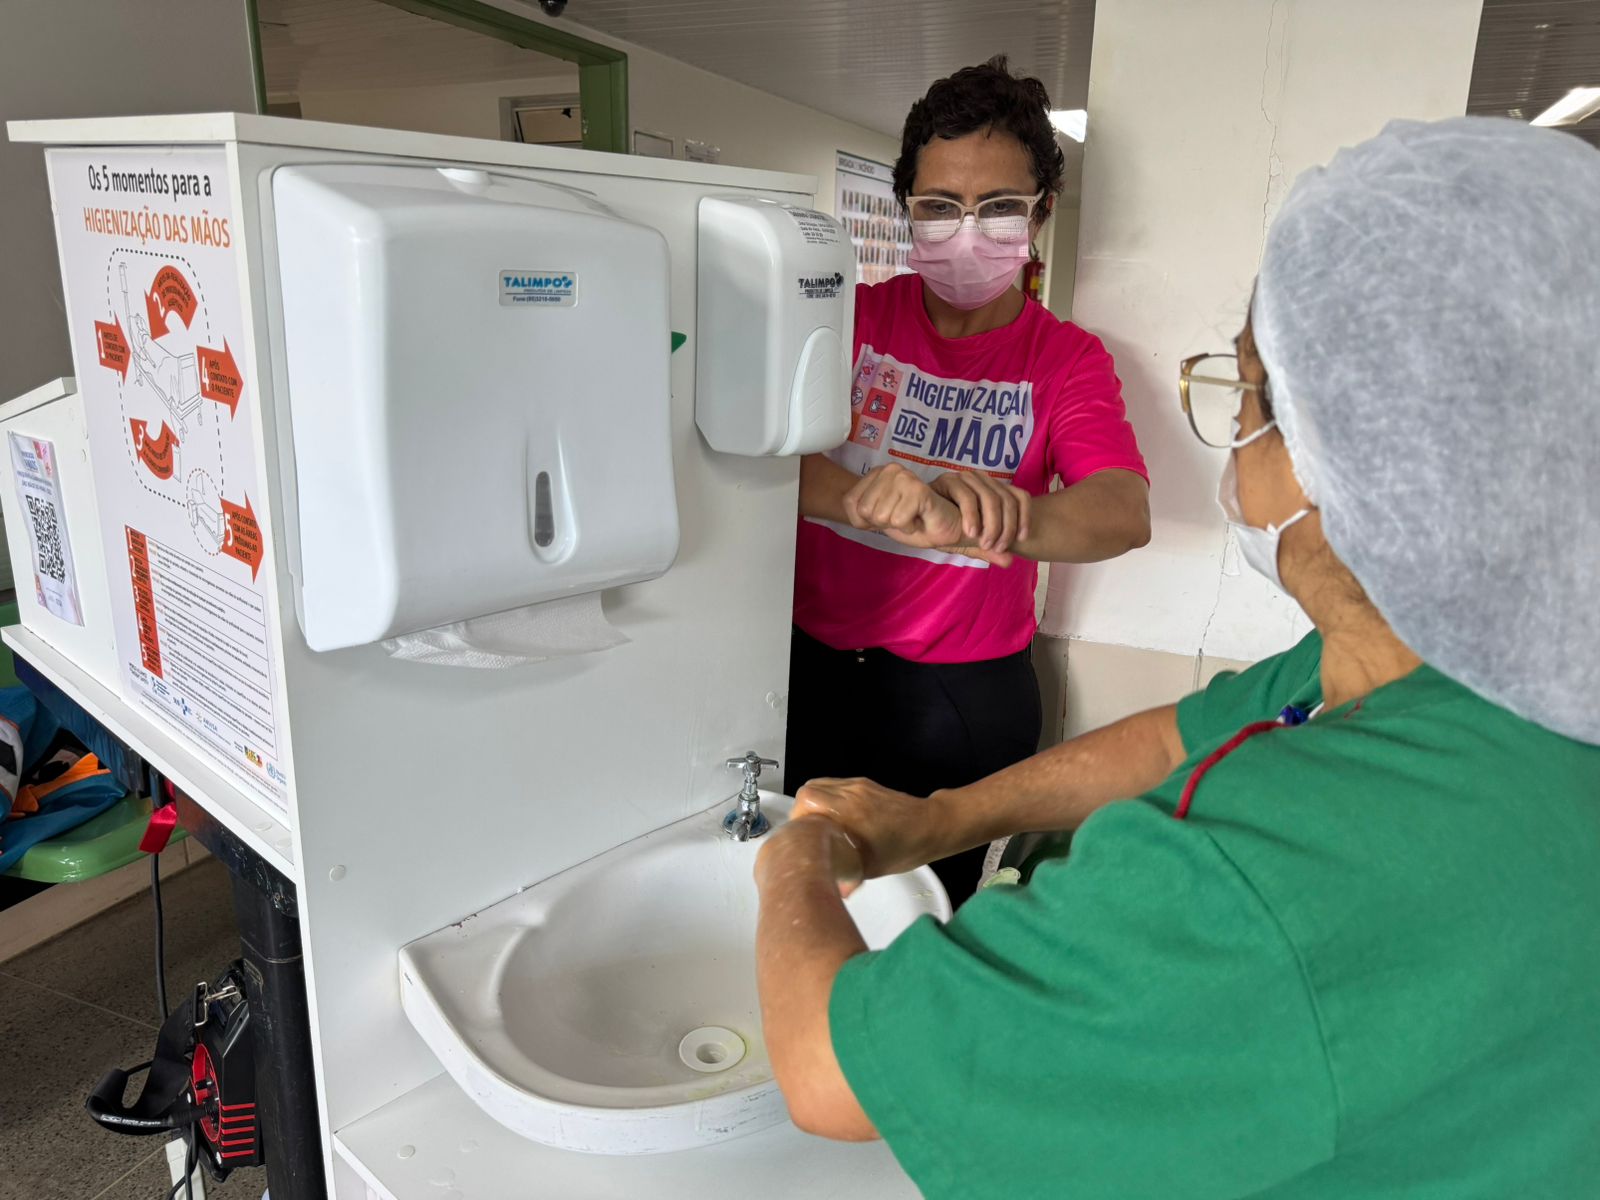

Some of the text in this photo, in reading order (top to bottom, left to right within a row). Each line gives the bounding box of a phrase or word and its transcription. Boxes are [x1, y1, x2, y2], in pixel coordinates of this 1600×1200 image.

[88, 164, 211, 202] Os 5 momentos para a
[83, 205, 230, 248] HIGIENIZAÇÃO DAS MÃOS
[504, 277, 562, 288] TALIMPO
[798, 277, 836, 288] TALIMPO
[153, 292, 165, 317] 2
[98, 329, 106, 359] 1
[202, 356, 210, 392] 4
[136, 424, 144, 450] 3
[893, 414, 929, 443] DAS
[928, 416, 1024, 470] MÃOS
[224, 512, 234, 547] 5
